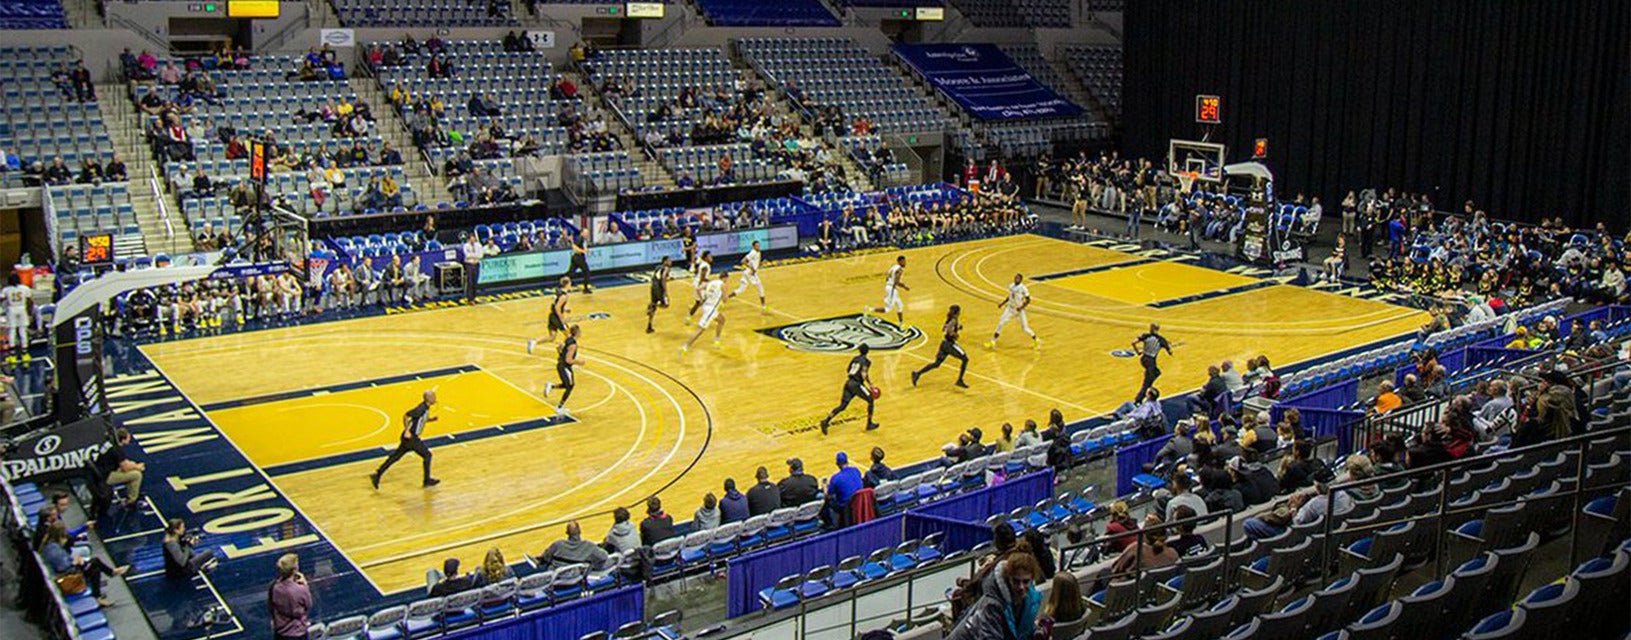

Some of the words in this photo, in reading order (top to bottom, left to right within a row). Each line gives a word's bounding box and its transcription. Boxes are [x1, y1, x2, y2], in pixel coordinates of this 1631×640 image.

[87, 246, 107, 261] 29
[104, 369, 220, 454] WAYNE
[166, 467, 320, 559] FORT
